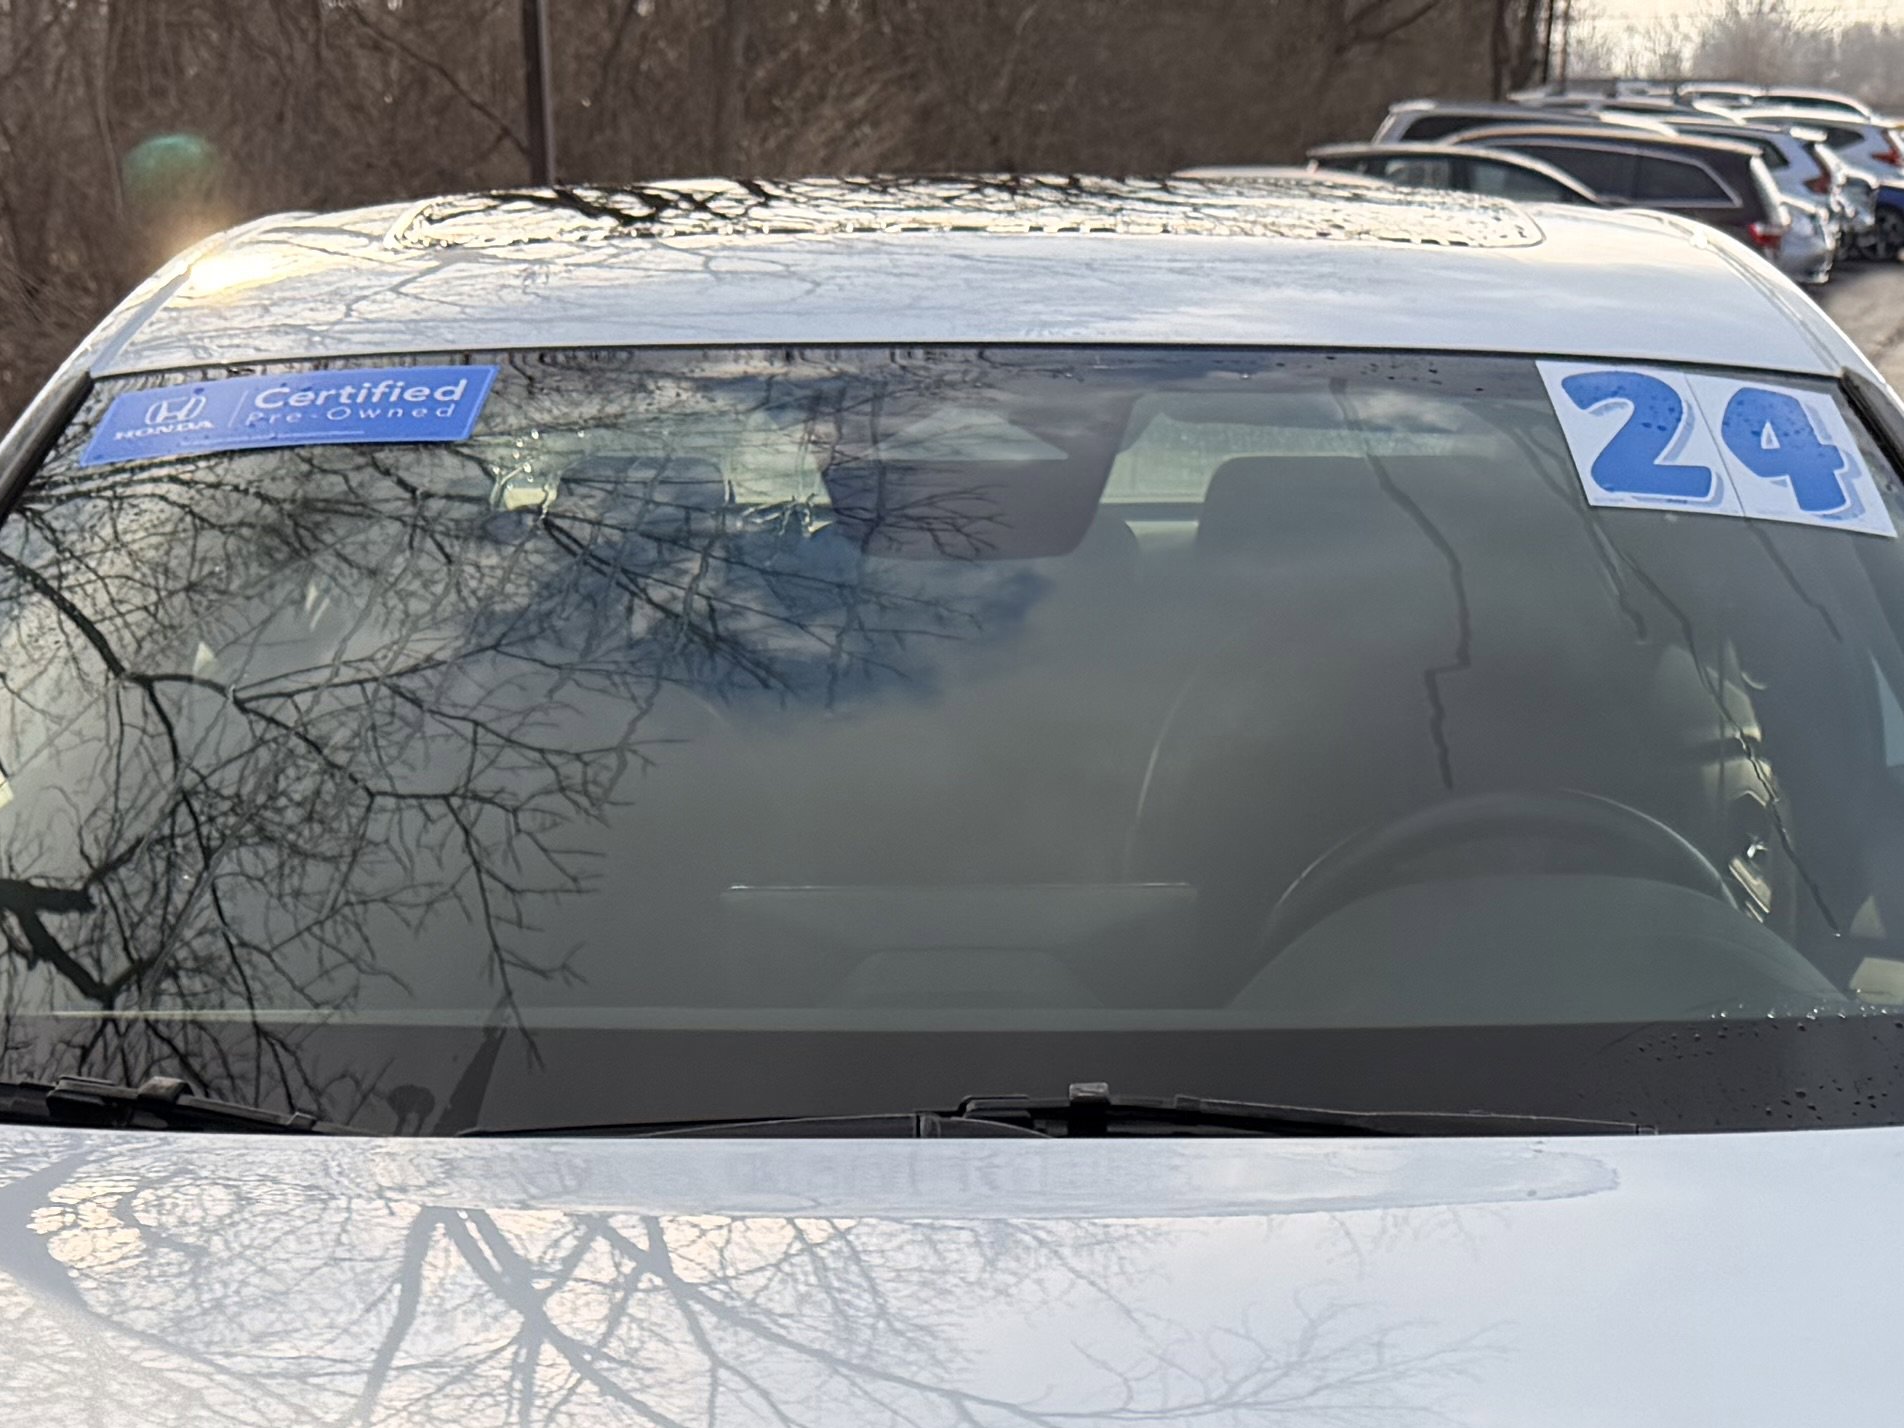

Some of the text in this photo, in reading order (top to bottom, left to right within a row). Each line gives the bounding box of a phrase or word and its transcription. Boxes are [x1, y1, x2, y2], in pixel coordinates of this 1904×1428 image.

[254, 379, 467, 409] Certified
[113, 420, 216, 440] HONDA
[1561, 370, 1853, 516] 24
